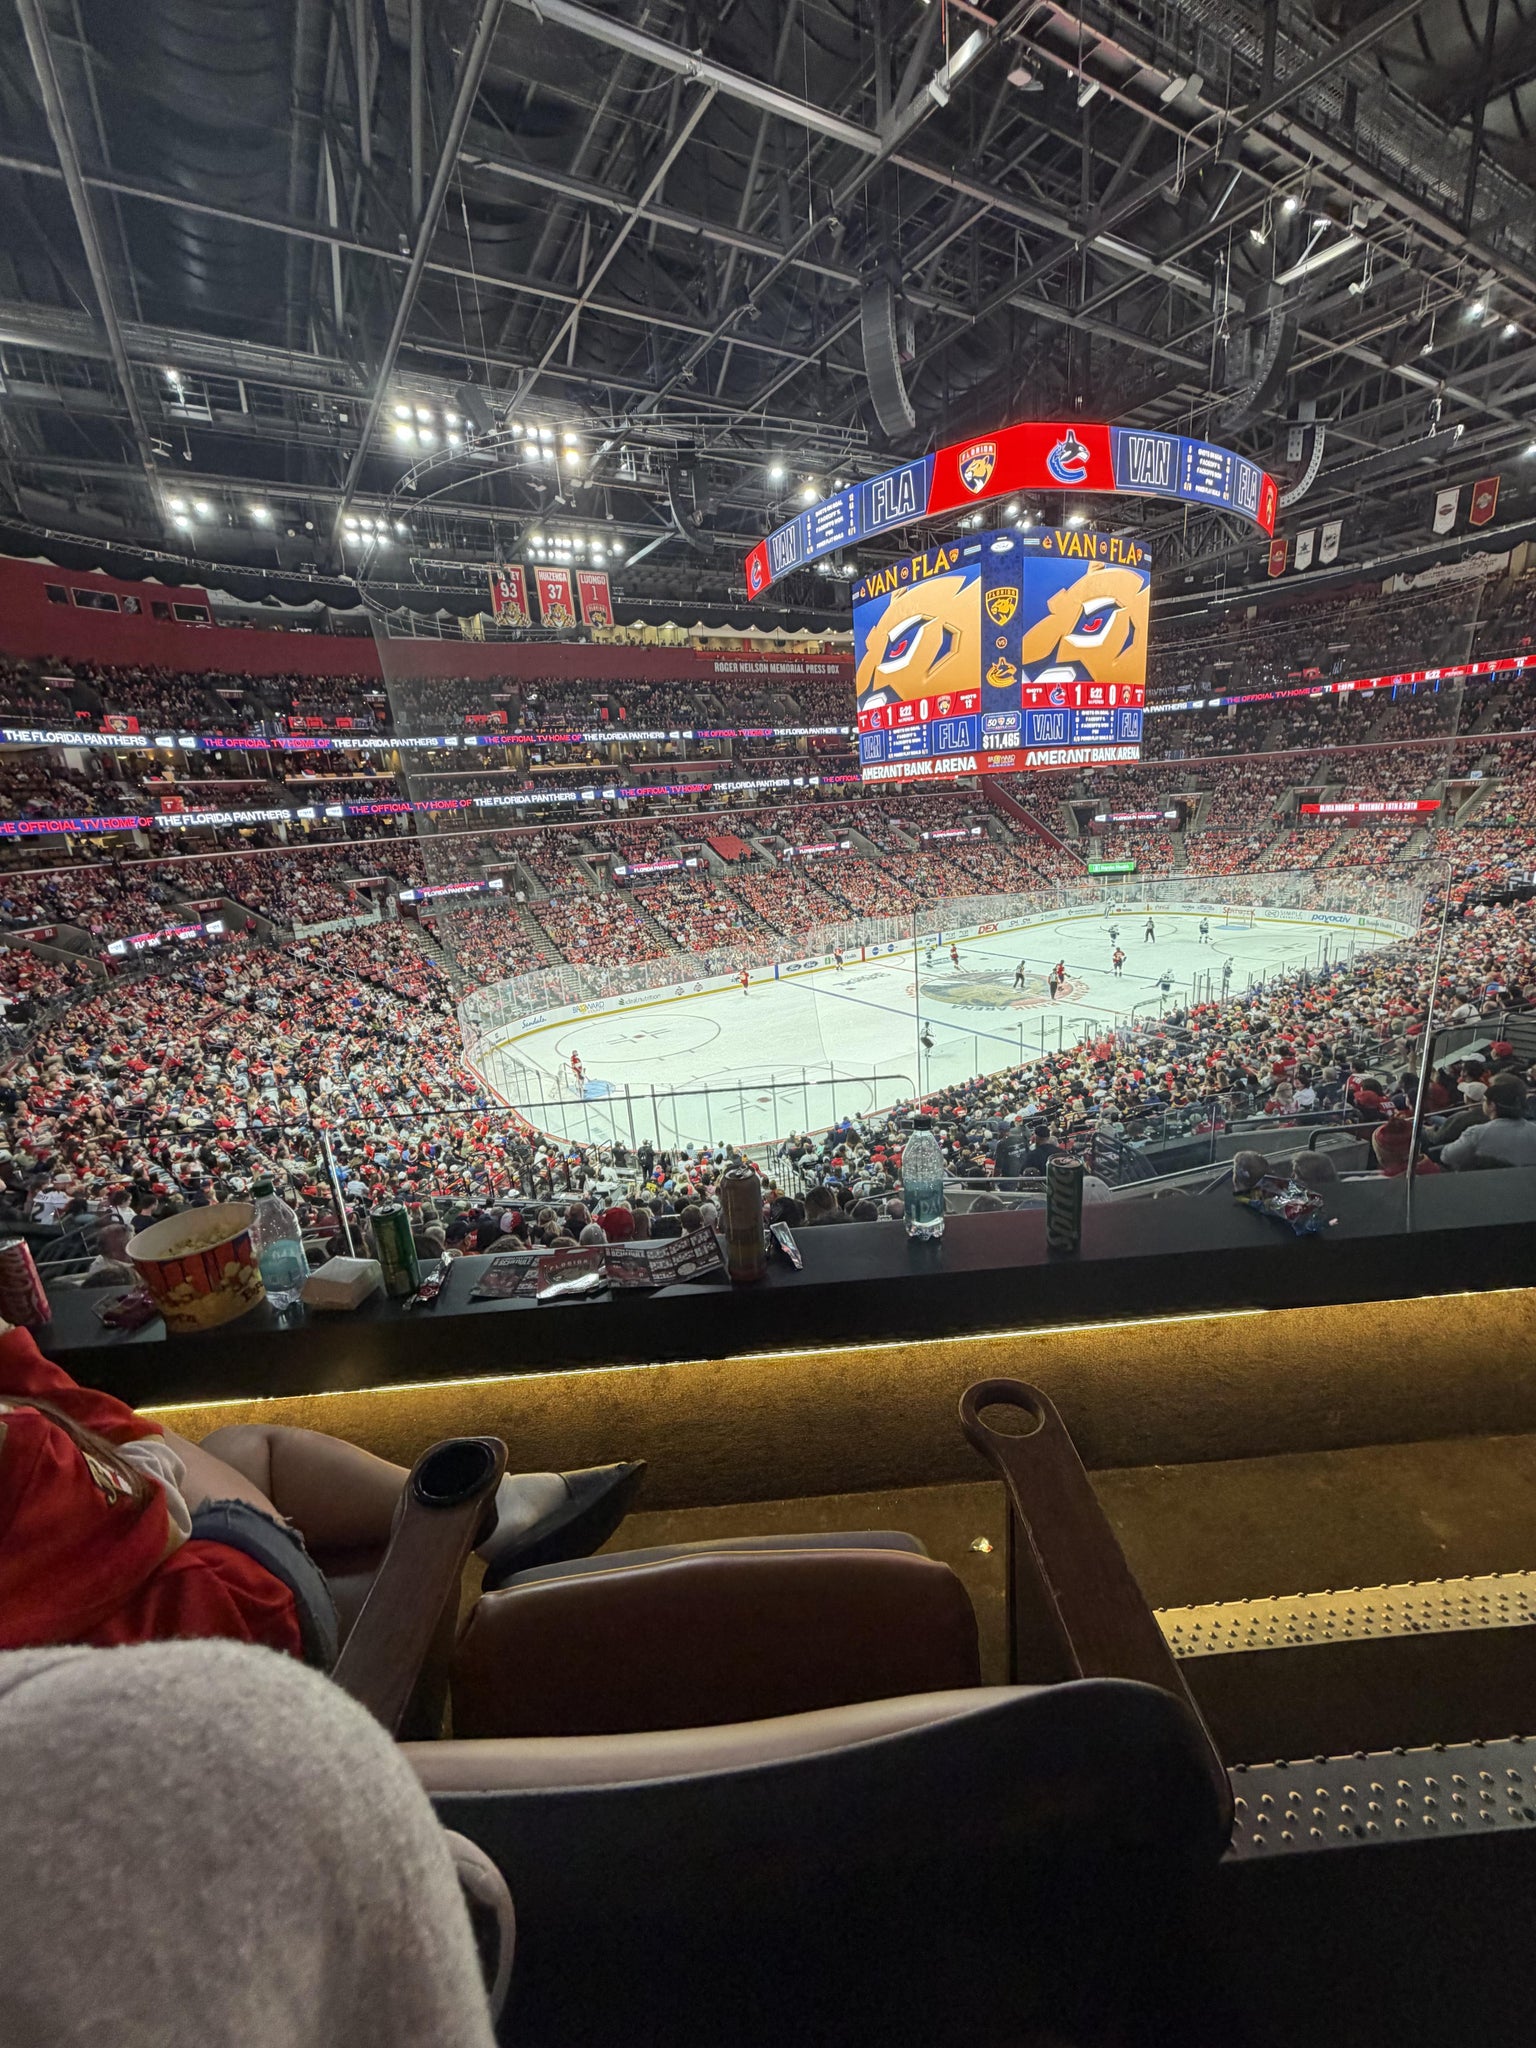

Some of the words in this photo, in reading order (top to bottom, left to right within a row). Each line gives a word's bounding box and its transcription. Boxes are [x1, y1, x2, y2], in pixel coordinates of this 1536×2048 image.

[961, 444, 993, 461] FLORIDA
[1129, 436, 1171, 486] VAN
[872, 469, 915, 525] FLA
[1238, 464, 1257, 512] FLA
[772, 525, 796, 572] VAN
[1055, 530, 1097, 559] VAN
[1110, 537, 1137, 566] FLA
[580, 574, 606, 585] LUONGO
[866, 569, 899, 598] VAN
[911, 548, 950, 582] FLA
[500, 582, 518, 598] 93
[547, 584, 563, 599] 37
[591, 585, 598, 600] 1
[714, 662, 738, 673] ROGER
[739, 662, 769, 673] NEILSON
[770, 663, 805, 674] MEMORIAL
[806, 664, 826, 674] PRESS
[826, 664, 840, 674] BOX
[1075, 684, 1082, 705] 1
[1109, 684, 1116, 706] 0
[1226, 696, 1240, 704] THE
[1241, 692, 1274, 702] OFFICIAL
[1287, 688, 1310, 698] HOME
[1312, 686, 1323, 694] OF
[886, 706, 892, 726] 1
[920, 698, 928, 720] 0
[1150, 702, 1188, 712] PANTHERS
[697, 730, 710, 738] THE
[711, 730, 738, 738] OFFICIAL
[774, 728, 786, 736] THE
[786, 728, 808, 736] FLORIDA
[1033, 714, 1064, 741] VAN
[1121, 713, 1139, 737] FLA
[3, 730, 32, 741] THE
[33, 731, 82, 743] FLORIDA
[83, 734, 147, 746] PANTHERS
[202, 738, 224, 747] THE
[226, 738, 270, 748] OFFICIAL
[270, 738, 288, 748] TV
[288, 738, 316, 748] HOME
[317, 738, 330, 748] OF
[332, 739, 352, 748] THE
[352, 738, 388, 748] FLORIDA
[390, 738, 438, 748] PANTHERS
[484, 735, 500, 744] THE
[501, 734, 536, 744] OFFICIAL
[536, 734, 550, 742] TV
[550, 734, 571, 742] HOME
[572, 734, 582, 742] OF
[582, 732, 598, 742] THE
[598, 732, 628, 741] FLORIDA
[629, 731, 664, 740] PANTHERS
[940, 721, 970, 750] FLA
[1025, 748, 1092, 766] AMERANT
[1092, 747, 1116, 761] BANK
[1117, 746, 1140, 760] ARENA
[862, 764, 904, 780] AMERANT
[904, 760, 933, 776] BANK
[934, 756, 978, 773] ARENA
[638, 787, 669, 796] OFFICIAL
[670, 786, 682, 794] TV
[683, 784, 702, 793] HOME
[703, 784, 712, 792] OF
[713, 782, 727, 791] THE
[727, 780, 755, 790] FLORIDA
[756, 778, 790, 788] PANTHERS
[348, 805, 370, 814] THE
[370, 802, 414, 813] OFFICIAL
[414, 802, 430, 810] TV
[430, 800, 458, 810] HOME
[460, 799, 472, 808] OF
[474, 796, 492, 806] THE
[492, 794, 530, 806] FLORIDA
[532, 792, 576, 804] PANTHERS
[0, 822, 17, 834] HE
[18, 820, 81, 832] OFFICIAL
[81, 818, 101, 830] TV
[102, 816, 138, 829] HOME
[138, 816, 153, 826] OF
[155, 815, 183, 826] THE
[182, 812, 230, 825] FLORIDA
[233, 810, 290, 822] PANTHERS
[978, 923, 999, 934] DEX
[1311, 914, 1352, 924] payactiv
[549, 1259, 588, 1271] FLORIDA
